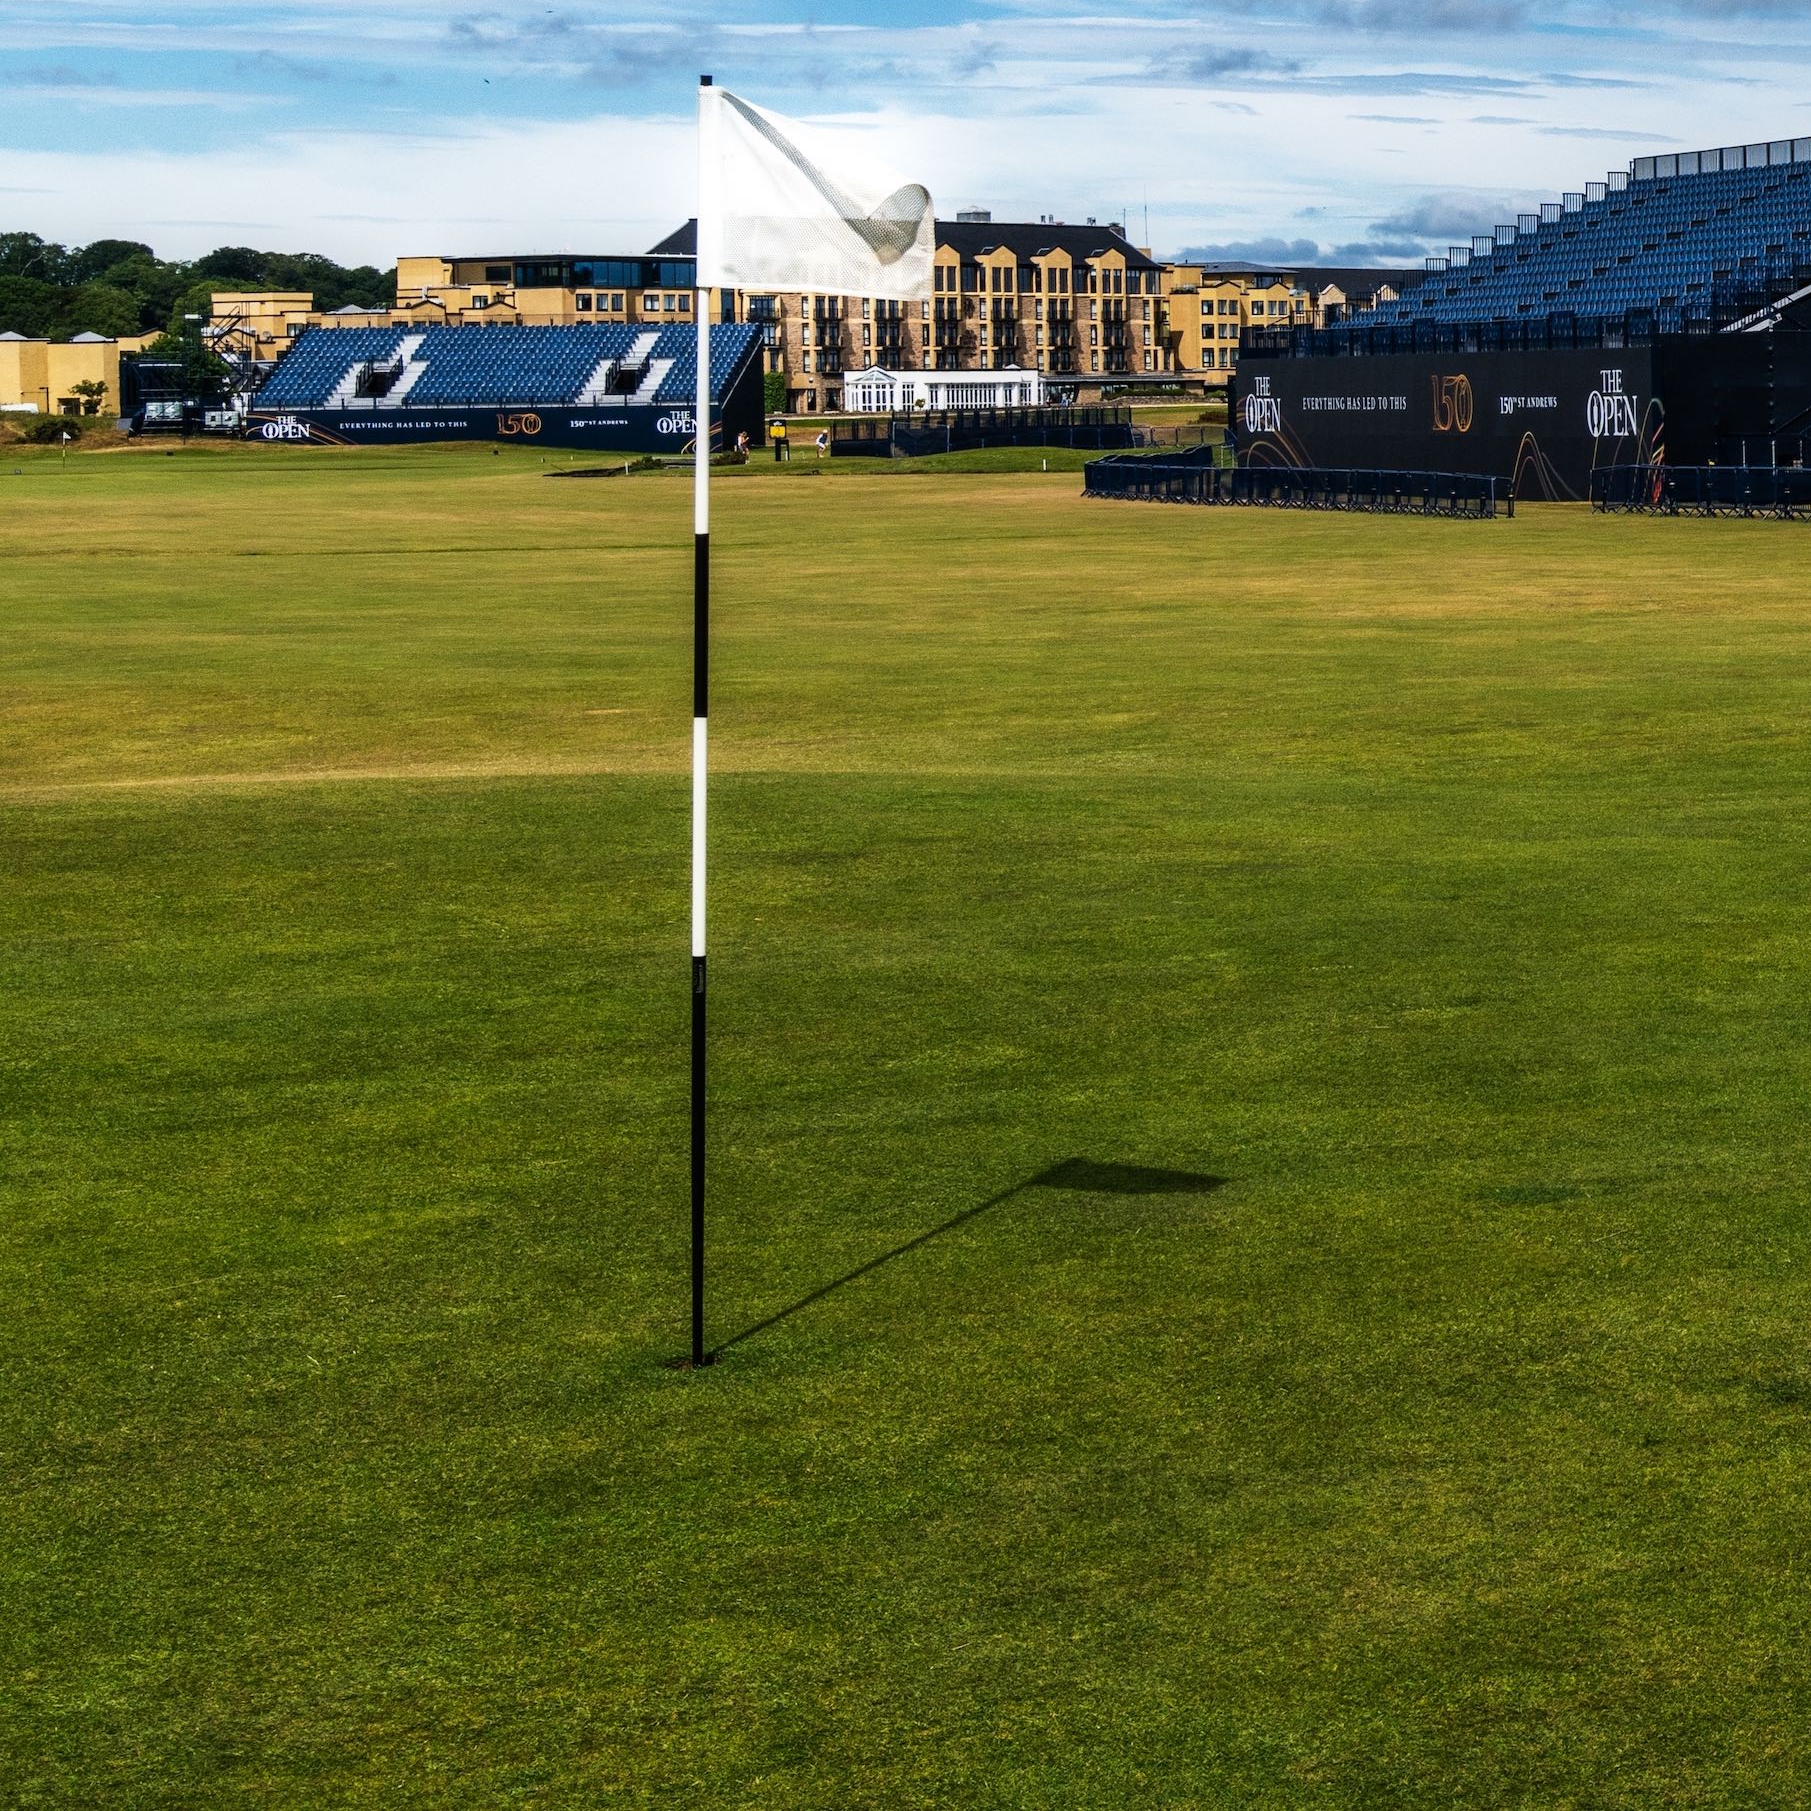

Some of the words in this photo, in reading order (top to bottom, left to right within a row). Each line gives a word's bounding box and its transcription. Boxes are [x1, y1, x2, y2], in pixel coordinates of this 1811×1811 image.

[1255, 377, 1271, 396] THE
[1600, 370, 1622, 393] THE
[1303, 397, 1345, 410] EVERYTHING
[1347, 397, 1361, 410] HAS
[1362, 397, 1376, 410] LED
[1378, 397, 1388, 410] TO
[1390, 396, 1407, 410] THIS
[1431, 374, 1473, 432] 150
[1518, 397, 1525, 407] ST
[1527, 397, 1558, 408] ANDREWS
[276, 416, 297, 424] THE
[670, 411, 690, 419] THE
[1245, 394, 1281, 433] OPEN
[1587, 390, 1637, 437] OPEN
[262, 423, 311, 439] OPEN
[339, 422, 394, 430] EVERYTHING
[496, 413, 542, 435] 150
